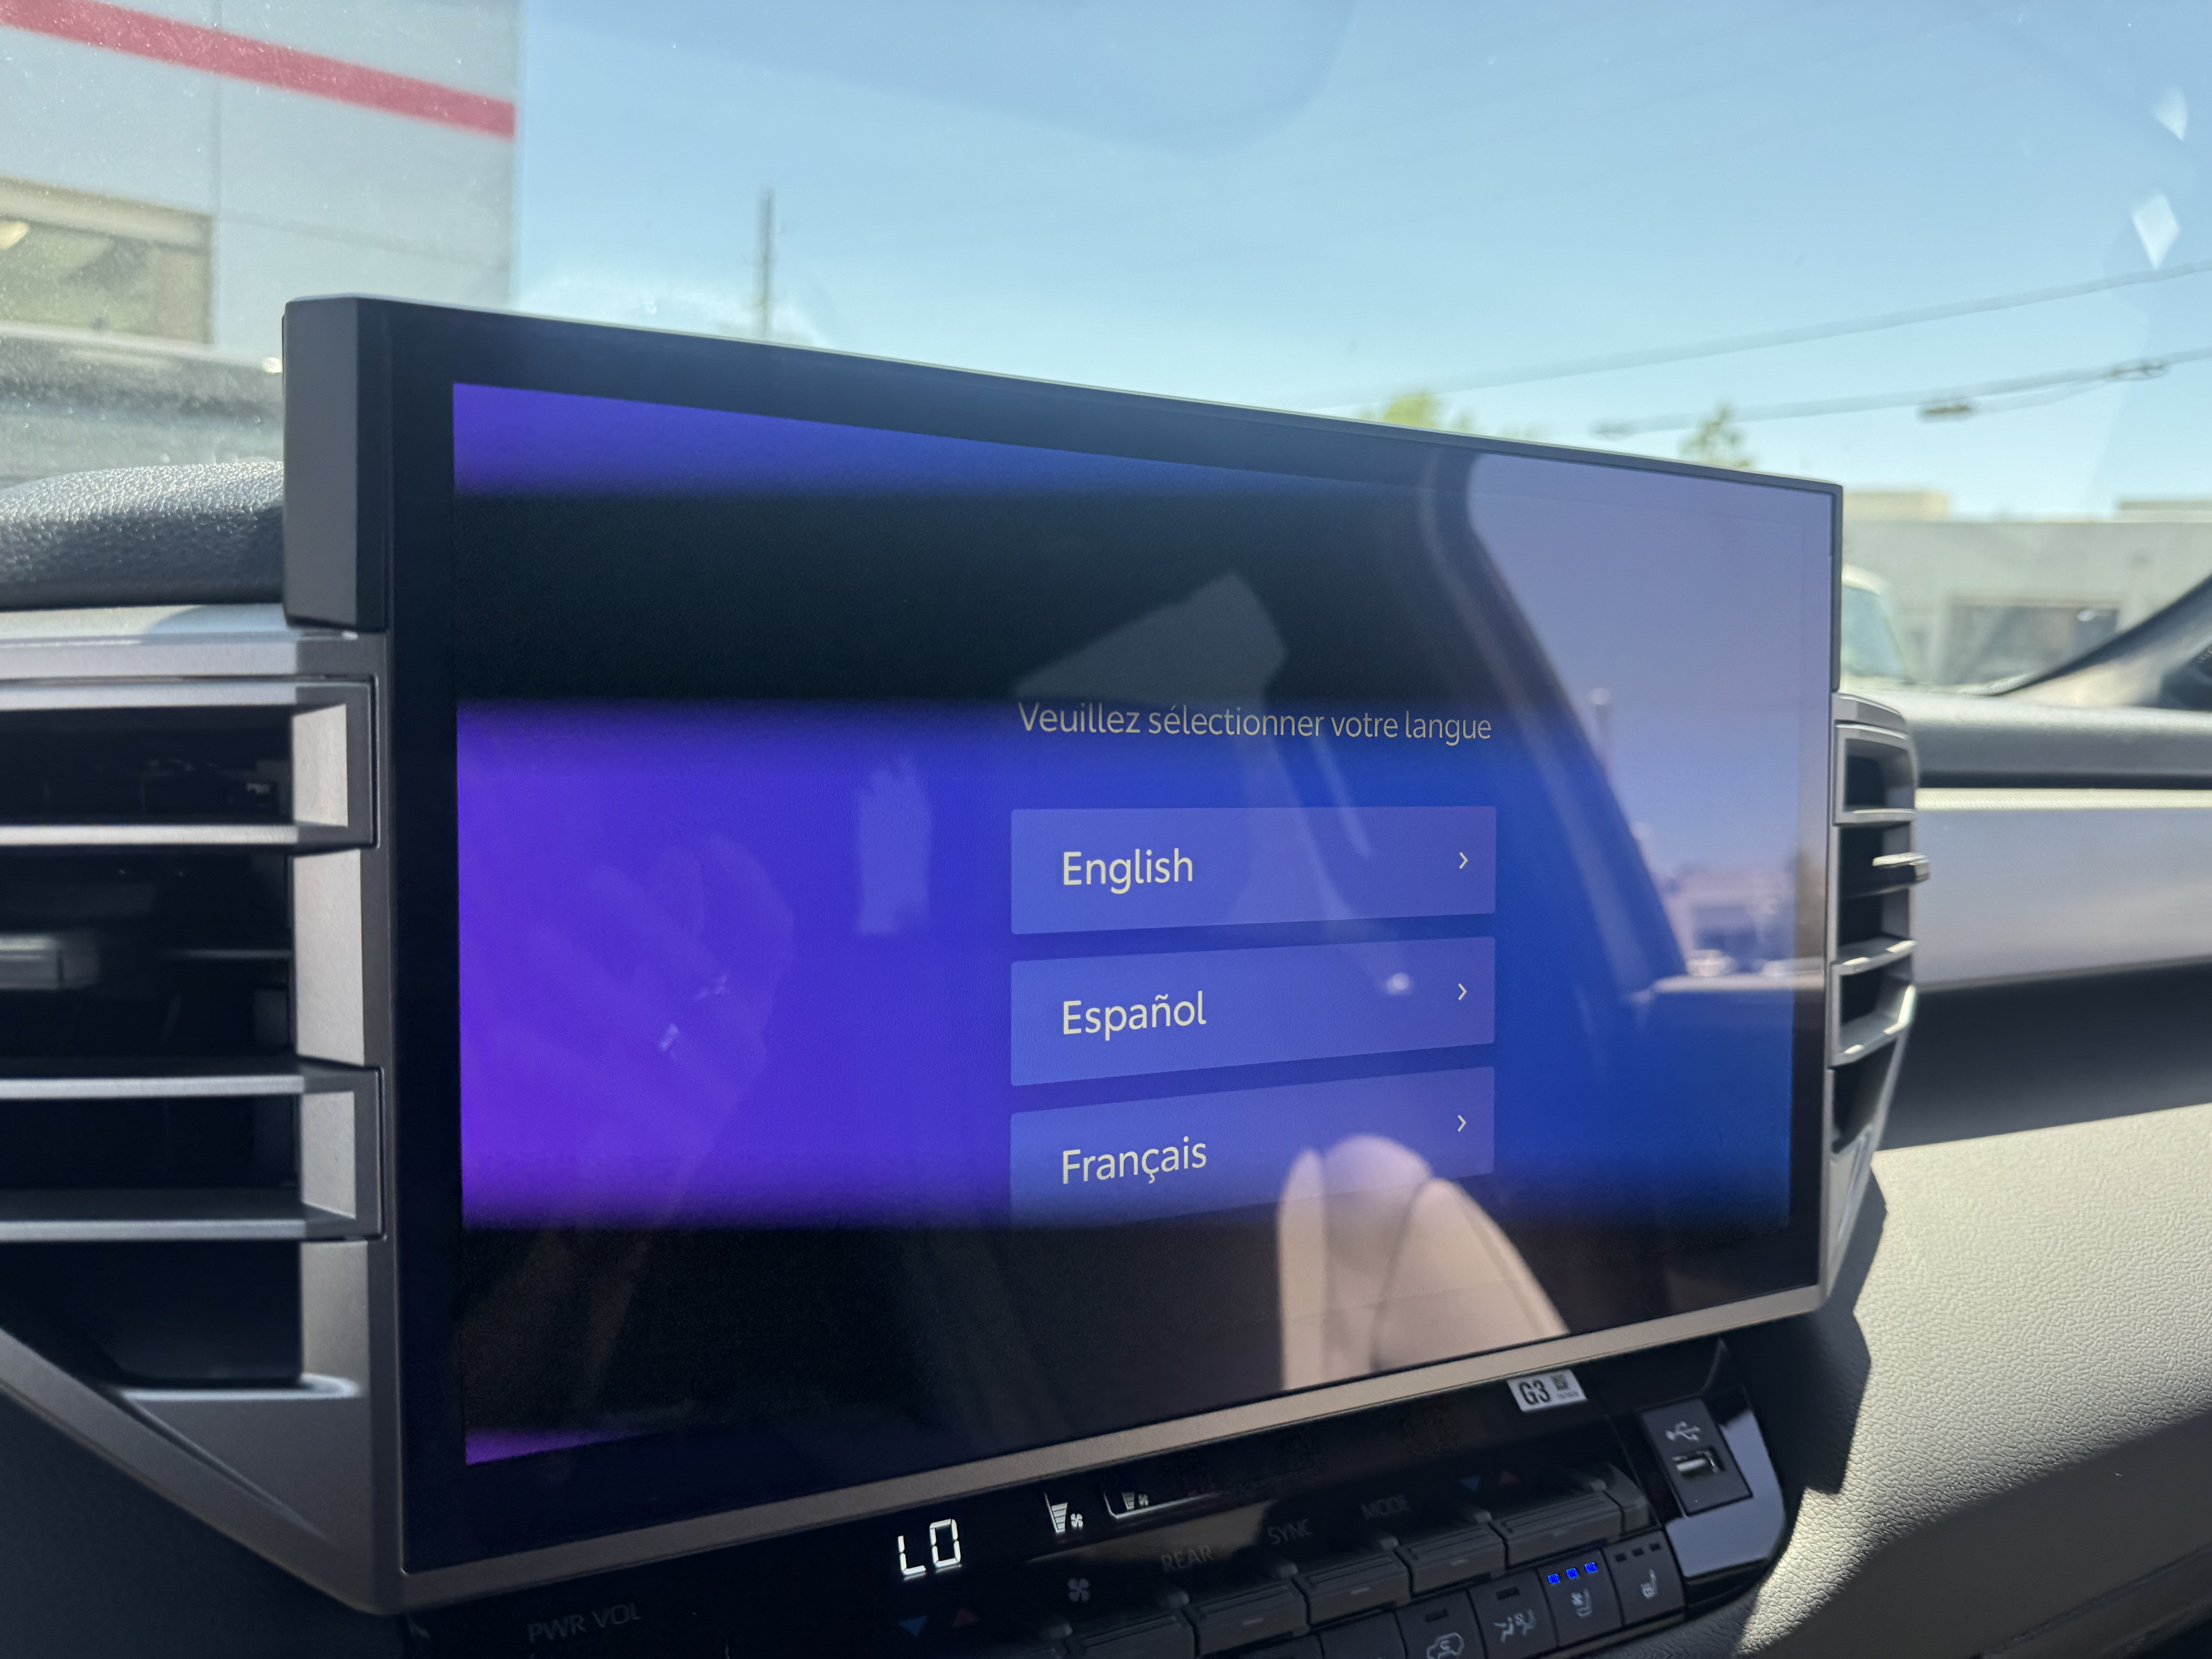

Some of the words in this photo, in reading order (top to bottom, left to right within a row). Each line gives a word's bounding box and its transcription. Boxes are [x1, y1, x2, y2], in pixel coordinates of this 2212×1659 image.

[1018, 702, 1140, 733] Veuillez
[1149, 705, 1325, 737] sélectionner
[1331, 714, 1398, 738] votre
[1405, 711, 1492, 746] langue
[1063, 848, 1194, 894] English
[1062, 990, 1207, 1041] Español
[1062, 1136, 1207, 1184] Français
[1518, 1380, 1551, 1405] G3
[1361, 1495, 1409, 1520] MODE
[1267, 1518, 1314, 1545] SYNC
[1160, 1545, 1214, 1572] REAR
[527, 1614, 587, 1644] PWR
[591, 1602, 642, 1629] VOL
